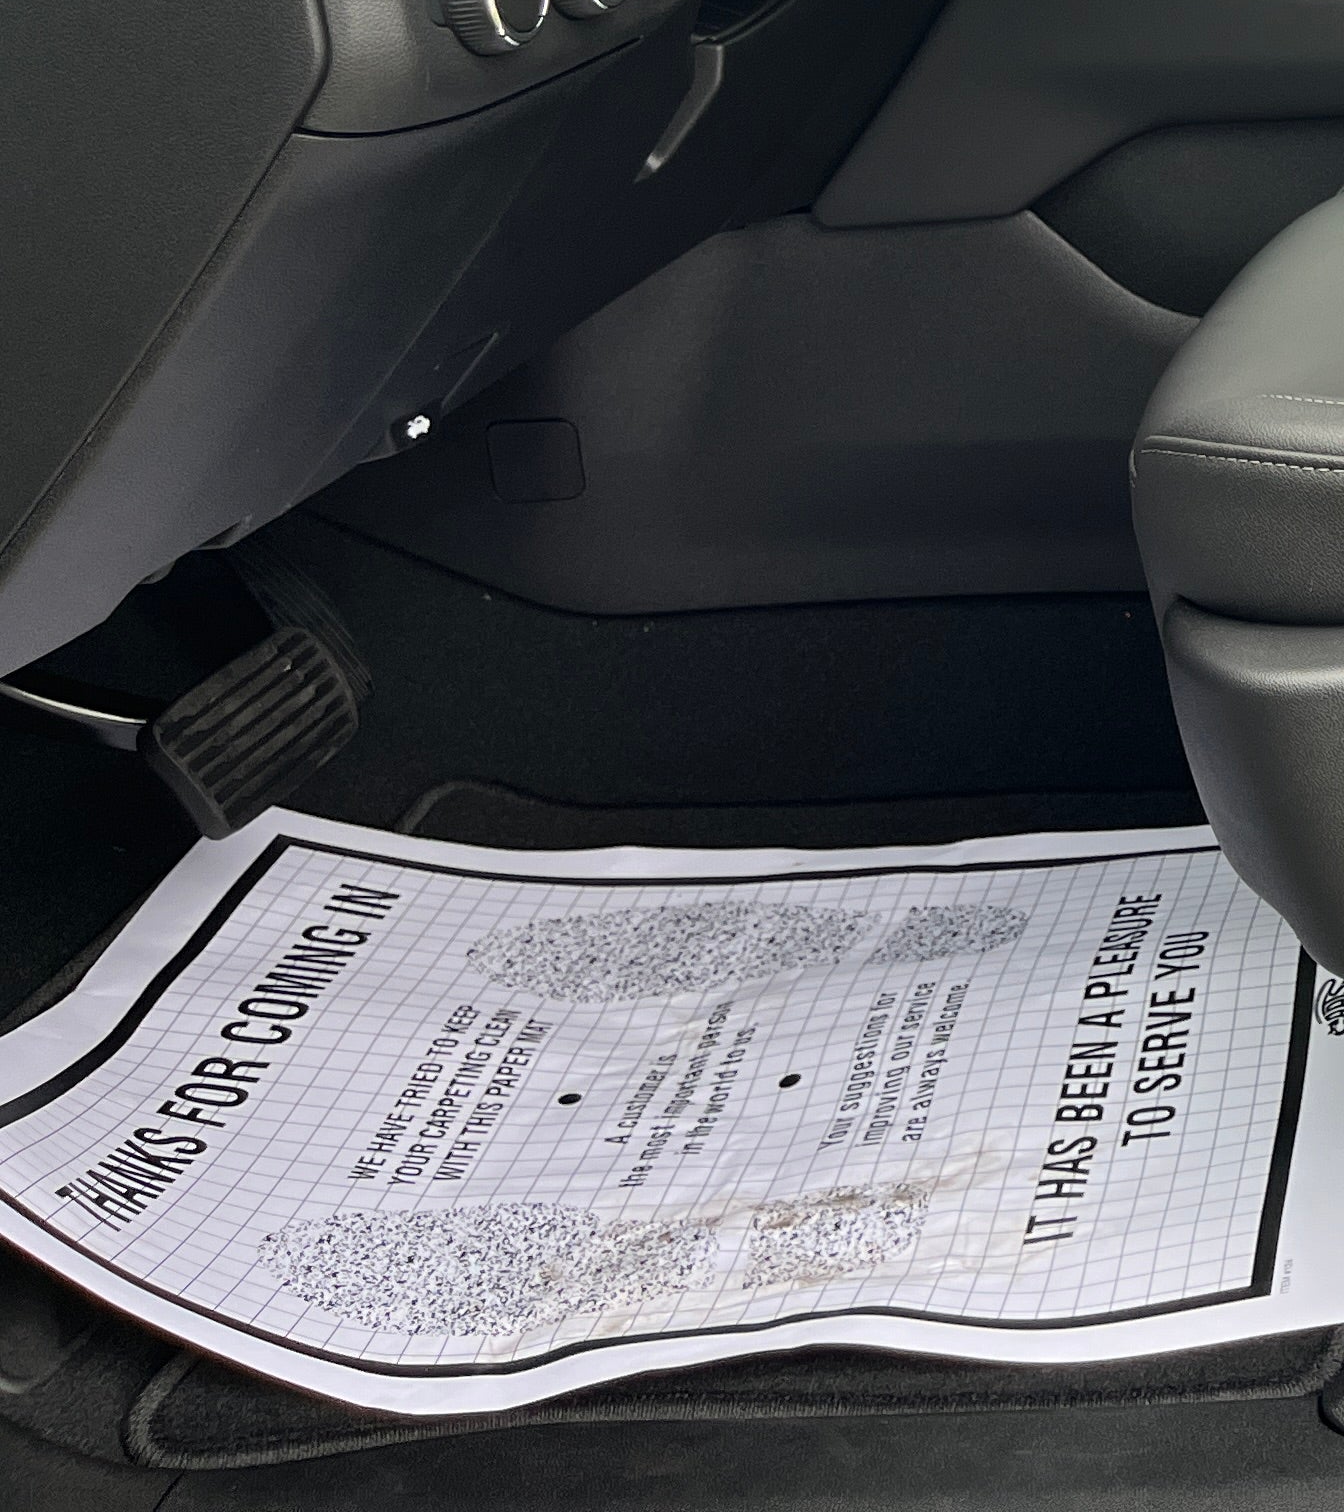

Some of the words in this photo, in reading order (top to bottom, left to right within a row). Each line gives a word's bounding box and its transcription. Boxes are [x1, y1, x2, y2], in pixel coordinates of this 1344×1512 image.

[1083, 893, 1163, 1001] PLEASURE
[1155, 931, 1210, 981] YOU
[441, 1005, 481, 1034] KEEP
[698, 1001, 734, 1050] person
[901, 981, 936, 1030] service
[931, 978, 972, 1046] welcome.
[1078, 1008, 1126, 1029] A
[55, 1127, 208, 1232] THANKS
[156, 1056, 271, 1128] FOR
[221, 925, 372, 1045] COMING
[324, 883, 401, 920] IN
[426, 1038, 459, 1056] TO
[652, 1053, 678, 1066] is
[719, 1049, 746, 1065] to
[891, 1035, 915, 1061] our
[1134, 987, 1196, 1093] SERVE
[395, 1062, 444, 1107] TRIED
[654, 1052, 711, 1119] important
[699, 1070, 738, 1114] world
[816, 1118, 855, 1151] Your
[840, 1013, 889, 1112] suggestions
[870, 992, 898, 1011] for
[910, 1049, 948, 1111] always
[1055, 1041, 1119, 1122] BEEN
[387, 1143, 438, 1185] YOUR
[419, 1050, 493, 1138] CARPETING
[474, 1009, 522, 1047] CLEAN
[433, 1140, 481, 1180] WITH
[461, 1102, 503, 1136] THIS
[485, 1047, 536, 1097] PAPER
[517, 1019, 553, 1043] MAT
[617, 1070, 668, 1128] customer
[854, 1064, 911, 1147] improving
[367, 1113, 415, 1152] HAVE
[604, 1134, 632, 1145] A
[639, 1124, 675, 1160] most
[685, 1117, 718, 1137] the
[902, 1115, 927, 1142] are
[1121, 1104, 1176, 1147] TO
[347, 1156, 387, 1179] WE
[673, 1143, 705, 1155] in
[1034, 1136, 1098, 1200] HAS
[618, 1165, 653, 1188] the
[1024, 1215, 1077, 1245] IT
